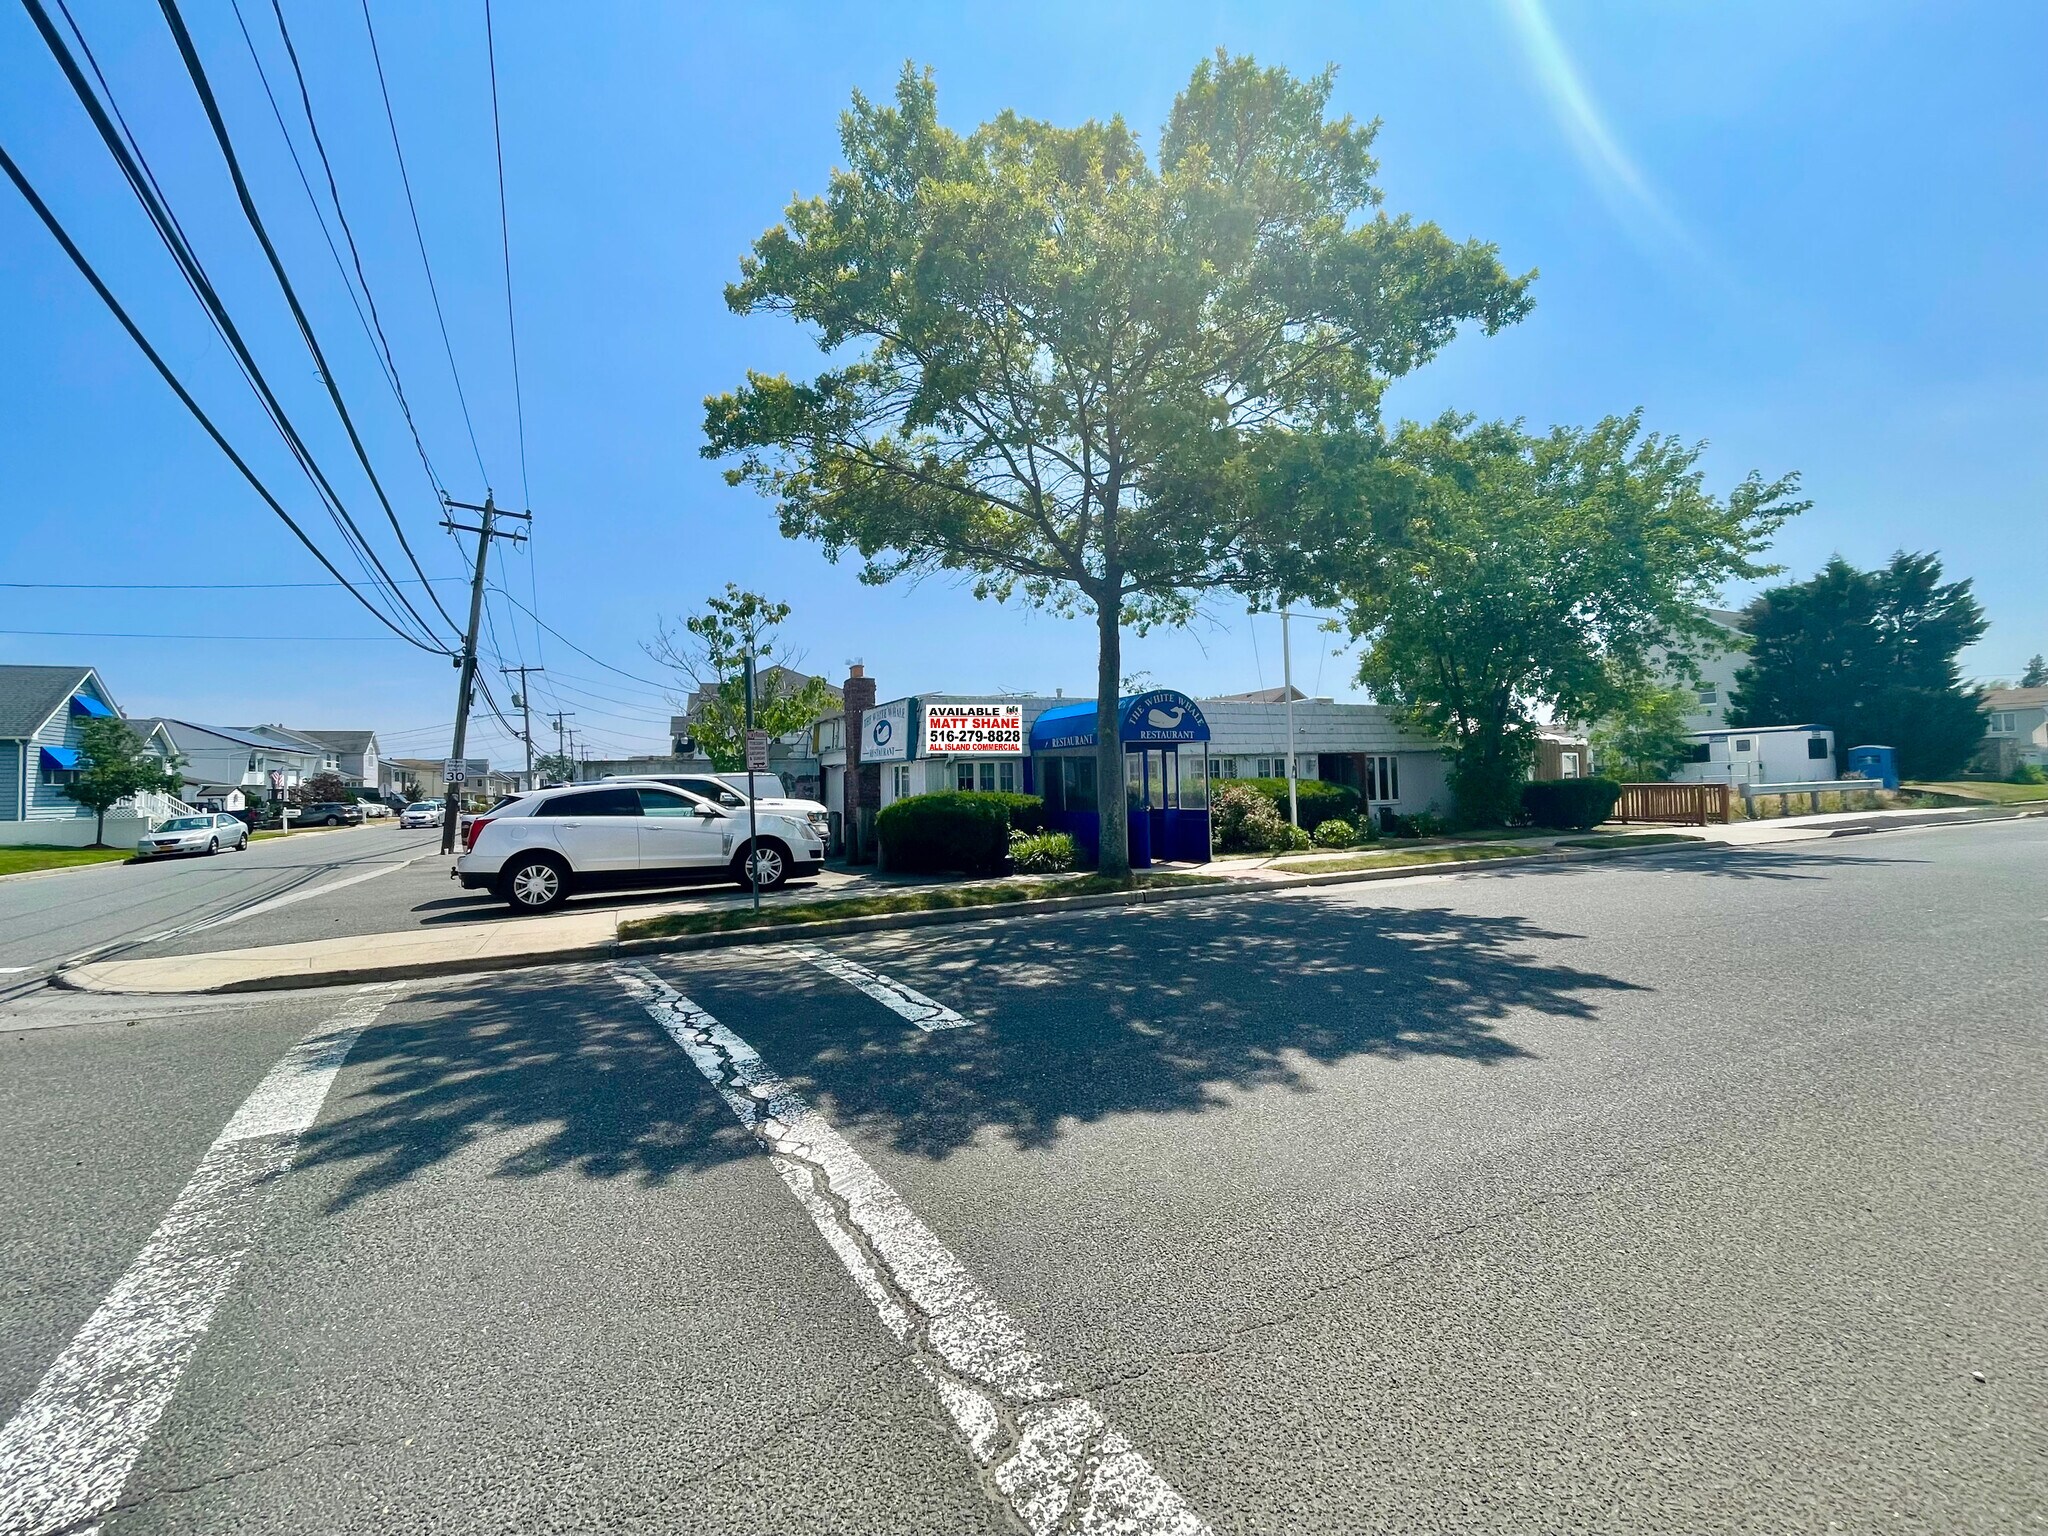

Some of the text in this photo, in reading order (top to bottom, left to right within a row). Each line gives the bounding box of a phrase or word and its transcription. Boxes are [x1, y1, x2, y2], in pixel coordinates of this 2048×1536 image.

[929, 707, 1000, 716] AVAILABLE
[1129, 704, 1144, 725] THE
[1144, 693, 1174, 706] WHITE
[1178, 696, 1204, 726] WHALE
[930, 718, 1019, 729] MATT SHANE
[930, 730, 1020, 742] 516-279-8828
[1140, 730, 1194, 739] RESTAURANT
[1051, 733, 1093, 748] RESTAURANT
[929, 743, 1020, 751] ALL ISLAND COMMERCIAL
[446, 772, 464, 781] 30
